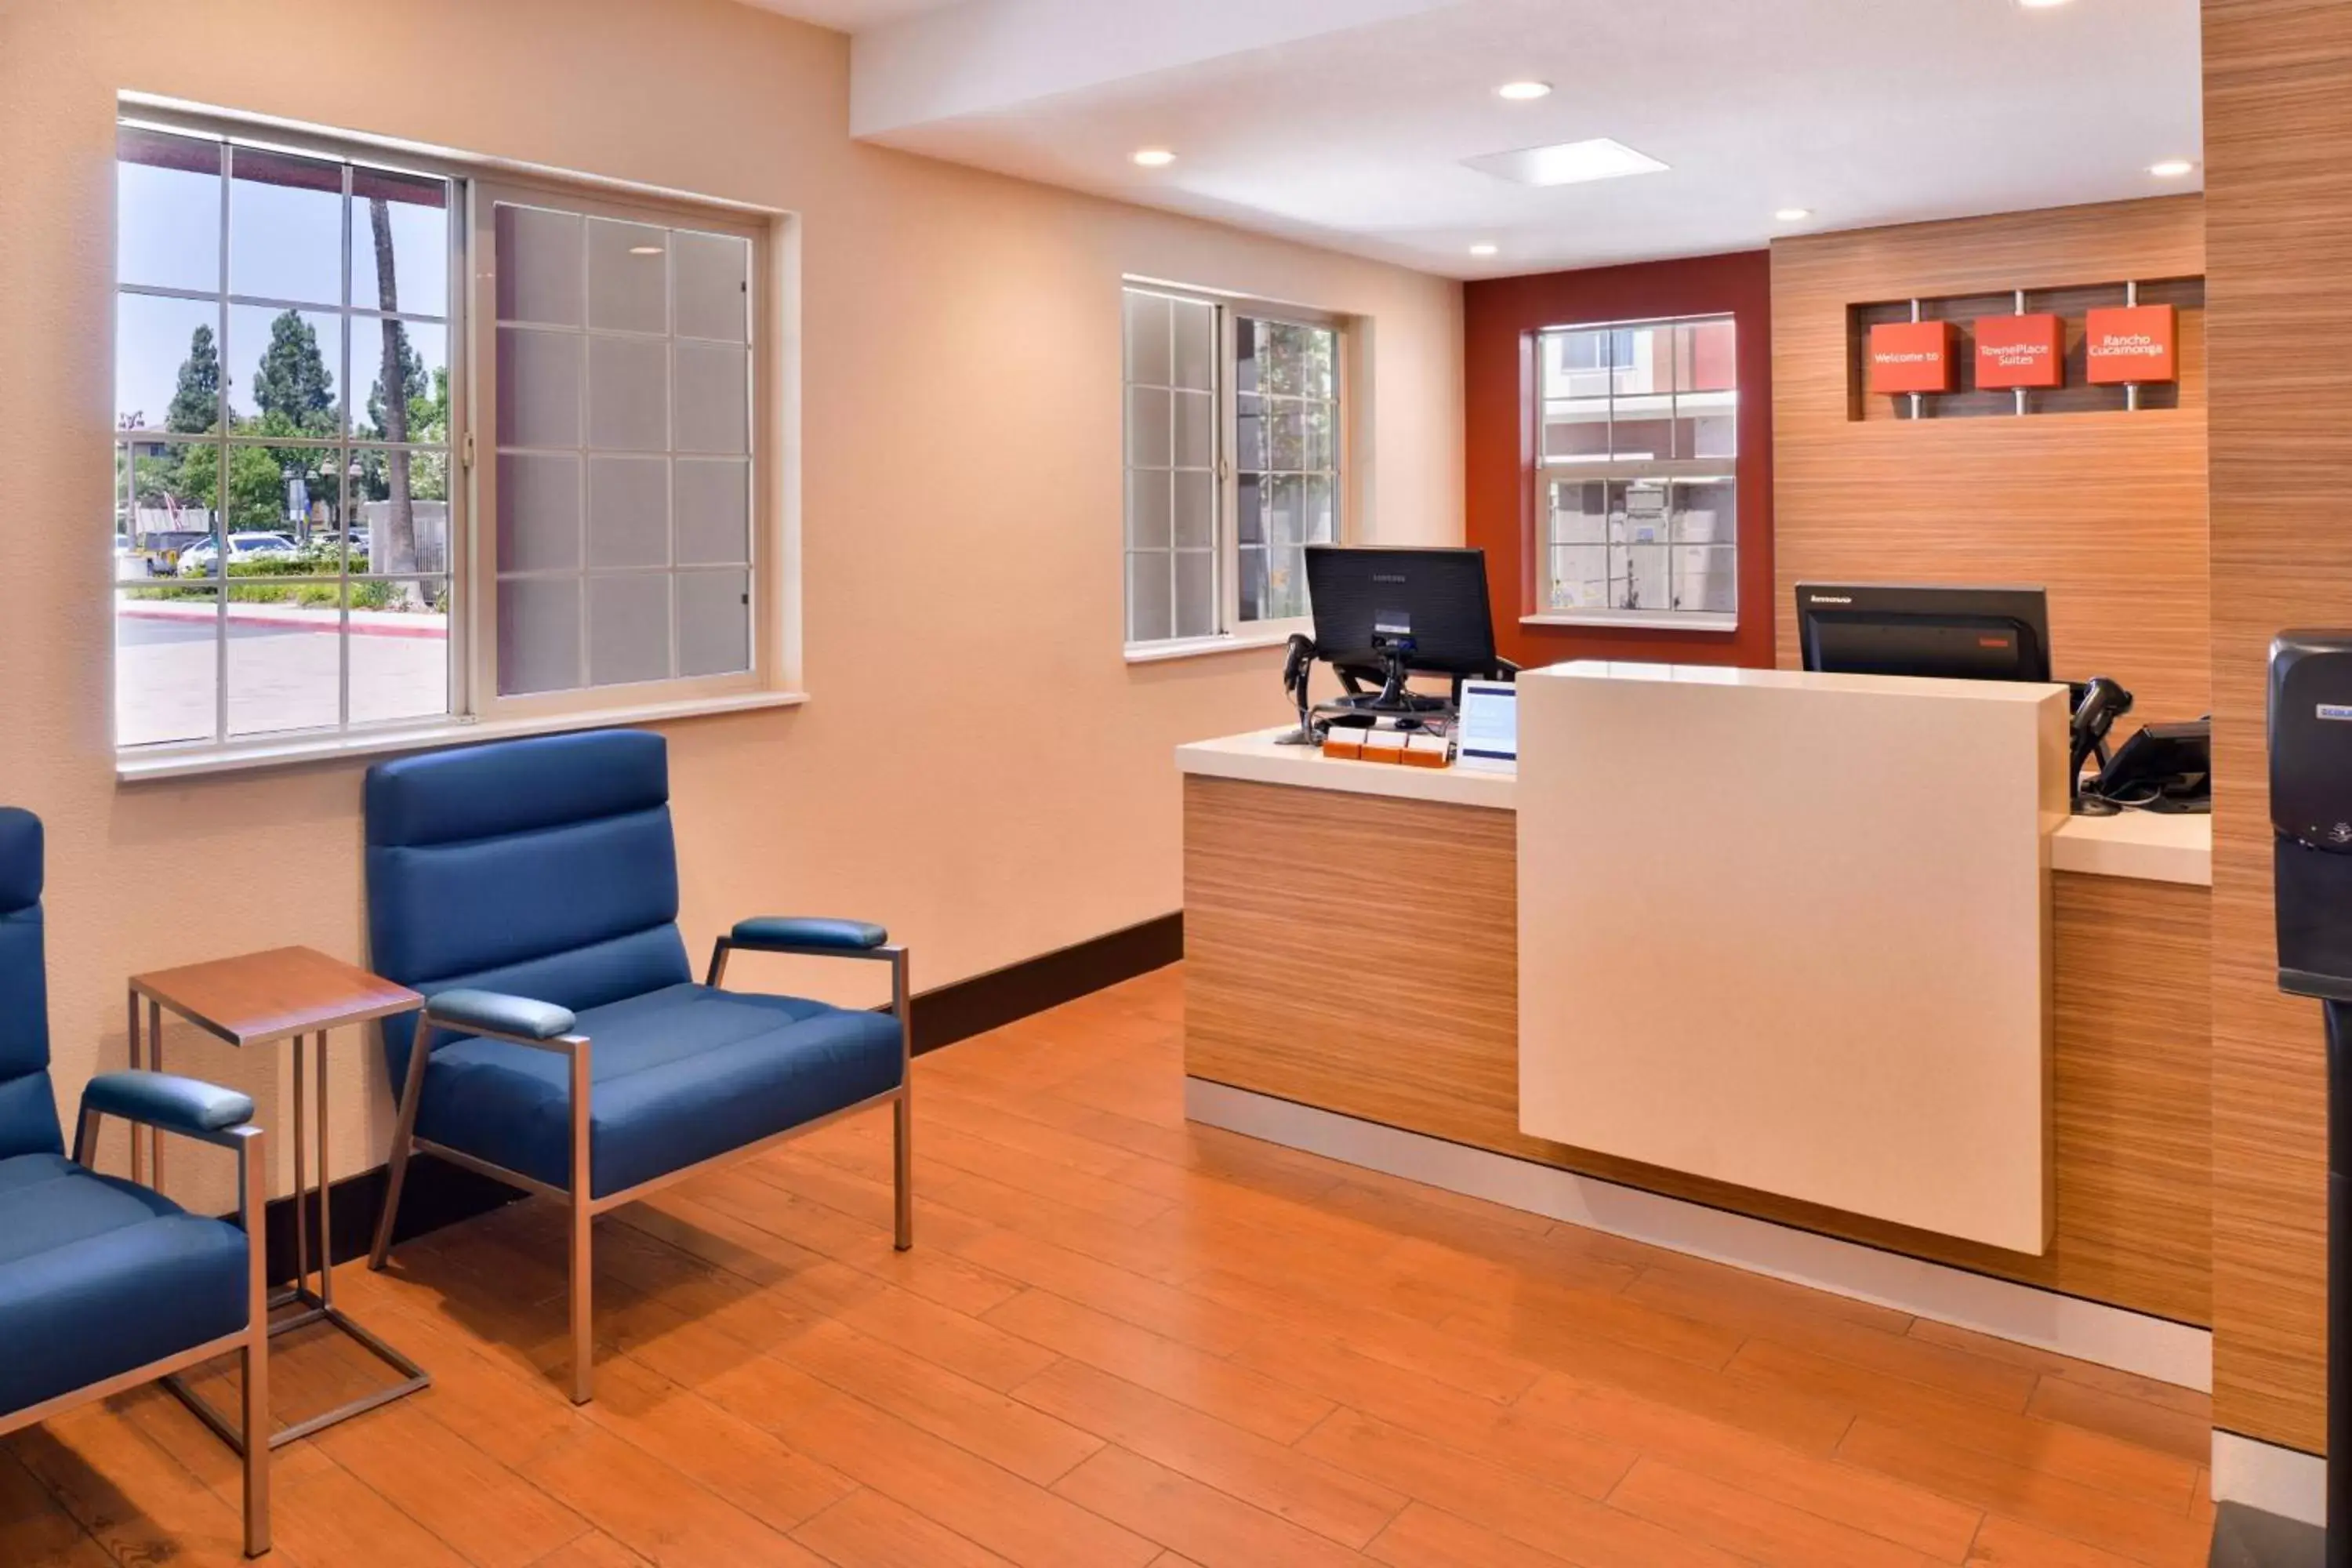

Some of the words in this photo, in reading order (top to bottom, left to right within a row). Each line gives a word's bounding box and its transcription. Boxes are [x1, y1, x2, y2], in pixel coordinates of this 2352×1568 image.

[2103, 333, 2151, 346] Rancho
[1980, 344, 2049, 356] TownePlace
[2088, 344, 2163, 358] Cucamonga
[1875, 352, 1924, 364] Welcome
[1926, 352, 1940, 362] to
[1998, 355, 2034, 367] Suites
